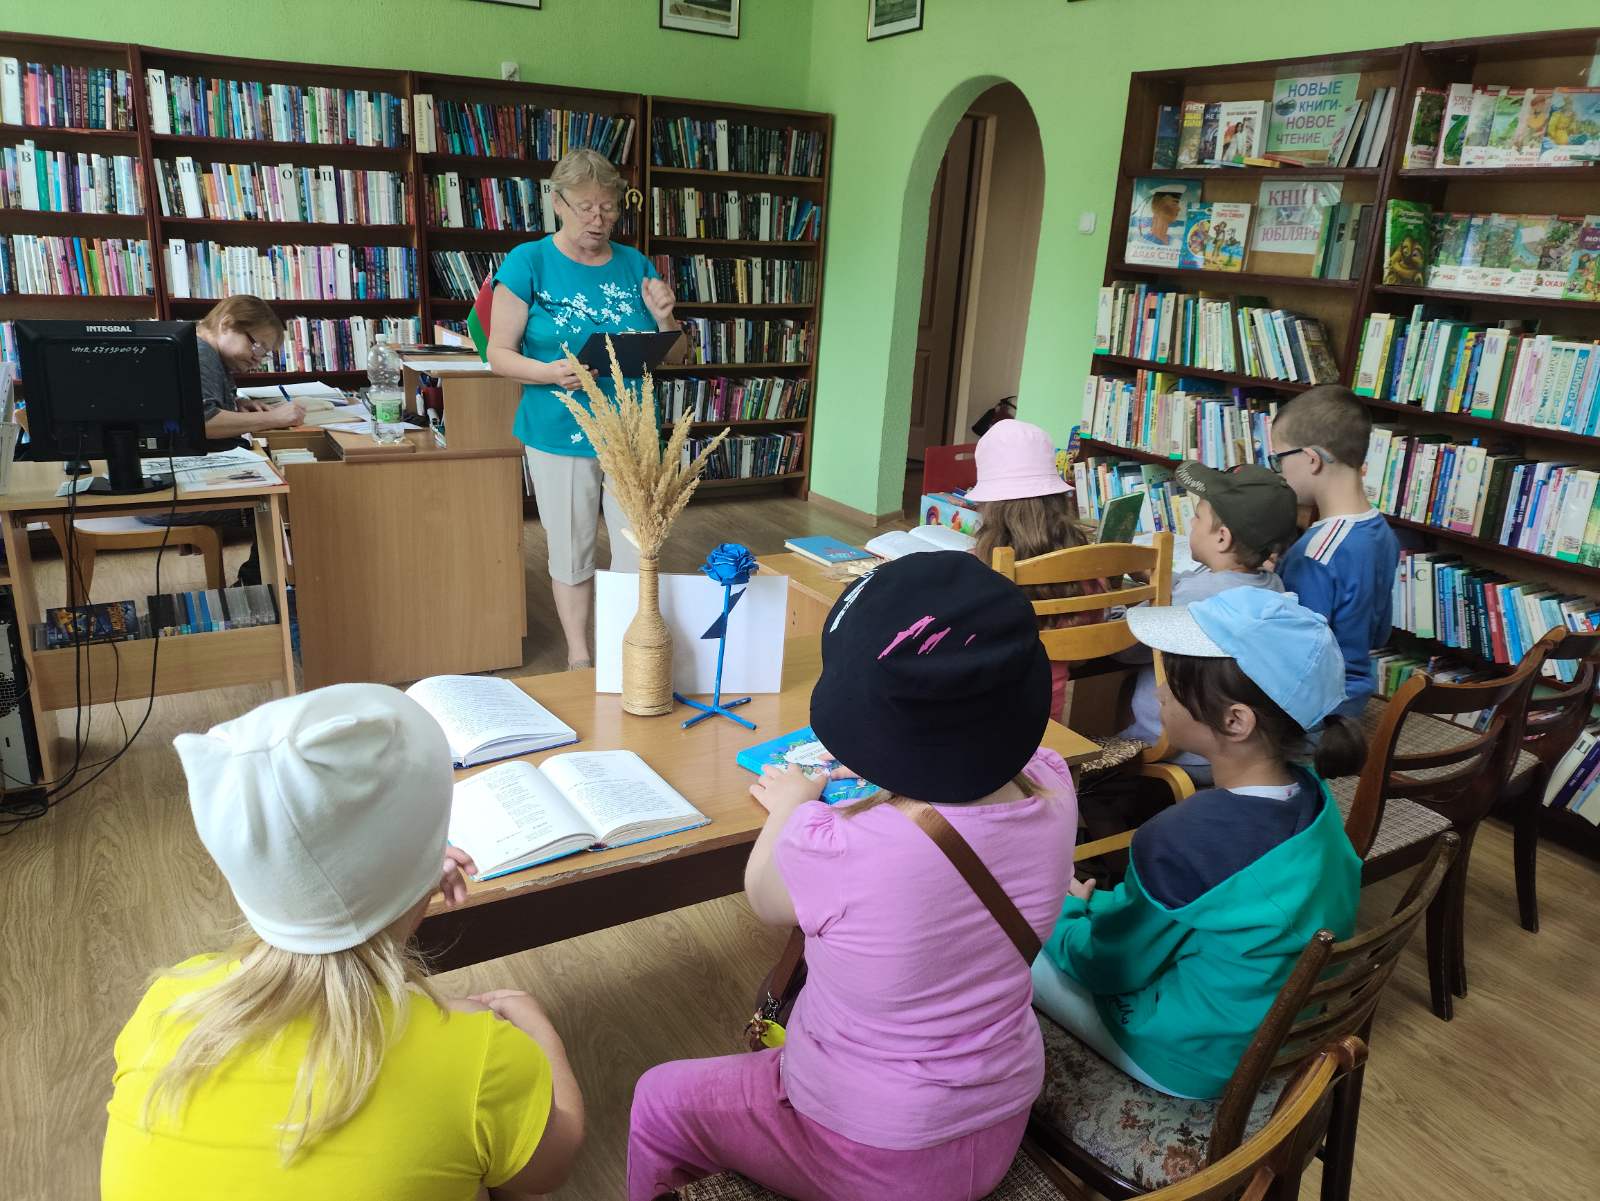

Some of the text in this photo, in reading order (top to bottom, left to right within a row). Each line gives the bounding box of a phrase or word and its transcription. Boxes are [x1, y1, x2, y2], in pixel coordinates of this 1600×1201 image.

[4, 63, 15, 75] Б
[151, 74, 163, 85] М
[1287, 80, 1344, 98] НОВЫЕ
[1286, 114, 1336, 130] НОВОЕ
[1276, 132, 1322, 145] ЧТЕНИЕ
[20, 150, 32, 163] В
[180, 162, 193, 174] Н
[282, 169, 293, 180] О
[449, 177, 457, 187] Б
[543, 184, 551, 194] В
[174, 244, 183, 255] Р
[337, 248, 348, 259] С
[85, 325, 133, 333] INTEGRAL
[1415, 568, 1427, 582] С
